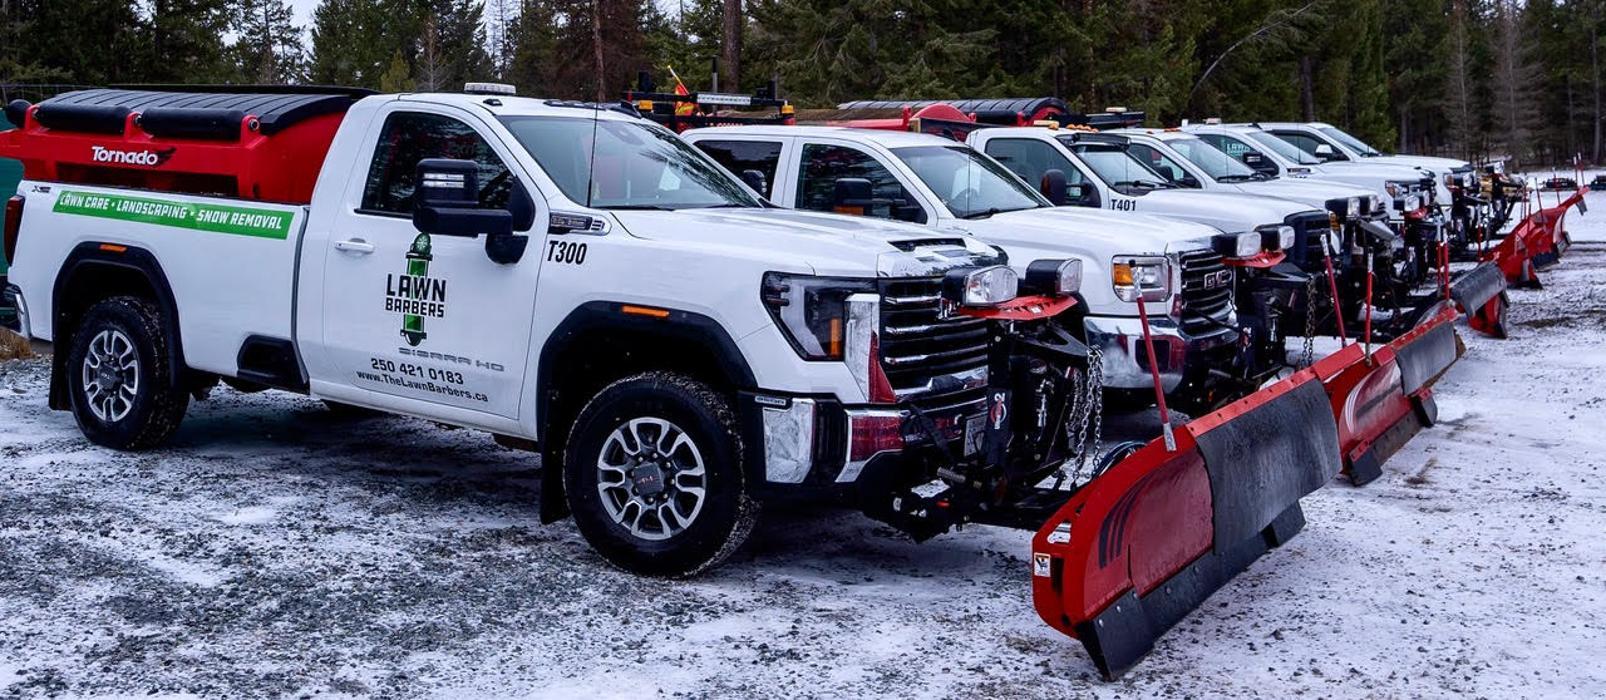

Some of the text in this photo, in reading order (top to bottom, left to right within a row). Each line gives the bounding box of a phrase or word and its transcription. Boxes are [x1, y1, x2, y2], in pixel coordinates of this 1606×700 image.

[91, 145, 159, 165] Tornado
[60, 193, 282, 229] LAWN CARE LANDSCAPING SNOW REMOVAL
[1111, 199, 1137, 211] T401
[547, 240, 588, 265] T300
[386, 273, 447, 303] LAWN
[385, 297, 445, 318] BARBERS
[370, 357, 464, 385] 250 421 0183
[398, 347, 505, 372] SIERRA HD
[356, 370, 489, 403] www.TheLawnBarbers.ca
